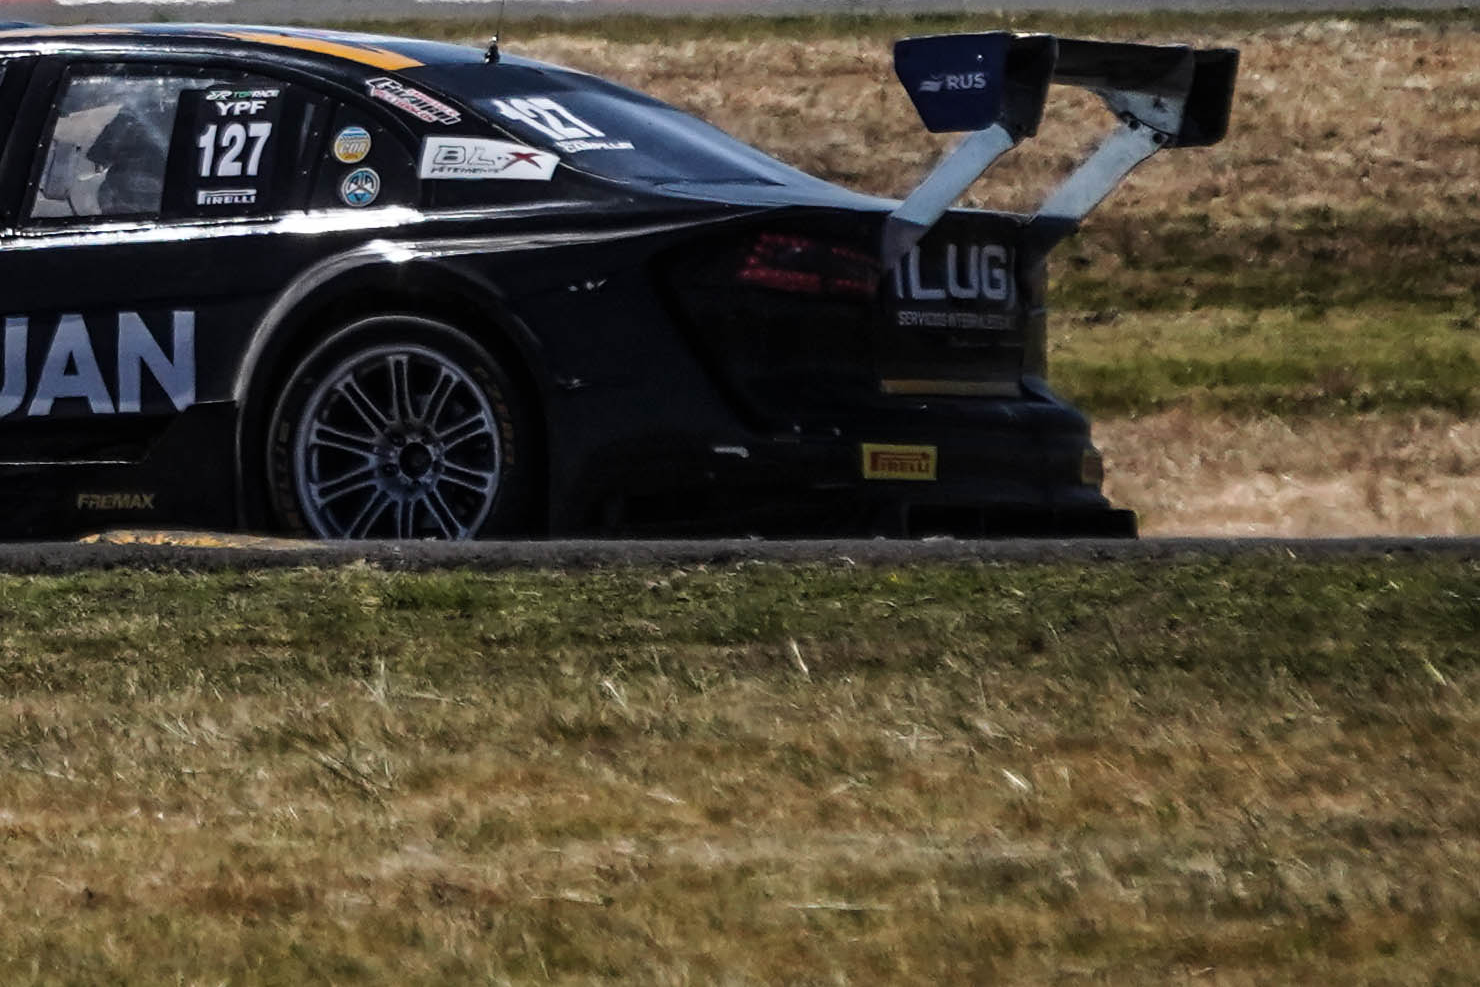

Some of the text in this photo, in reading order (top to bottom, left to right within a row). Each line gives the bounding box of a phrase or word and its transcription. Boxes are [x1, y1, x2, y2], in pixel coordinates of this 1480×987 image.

[946, 73, 987, 91] RUS
[216, 100, 267, 116] YPF
[490, 96, 606, 141] 127
[198, 122, 273, 177] 127
[197, 189, 257, 205] PIRELLI
[869, 450, 931, 473] PIRELLI
[77, 493, 156, 511] FREMAX
